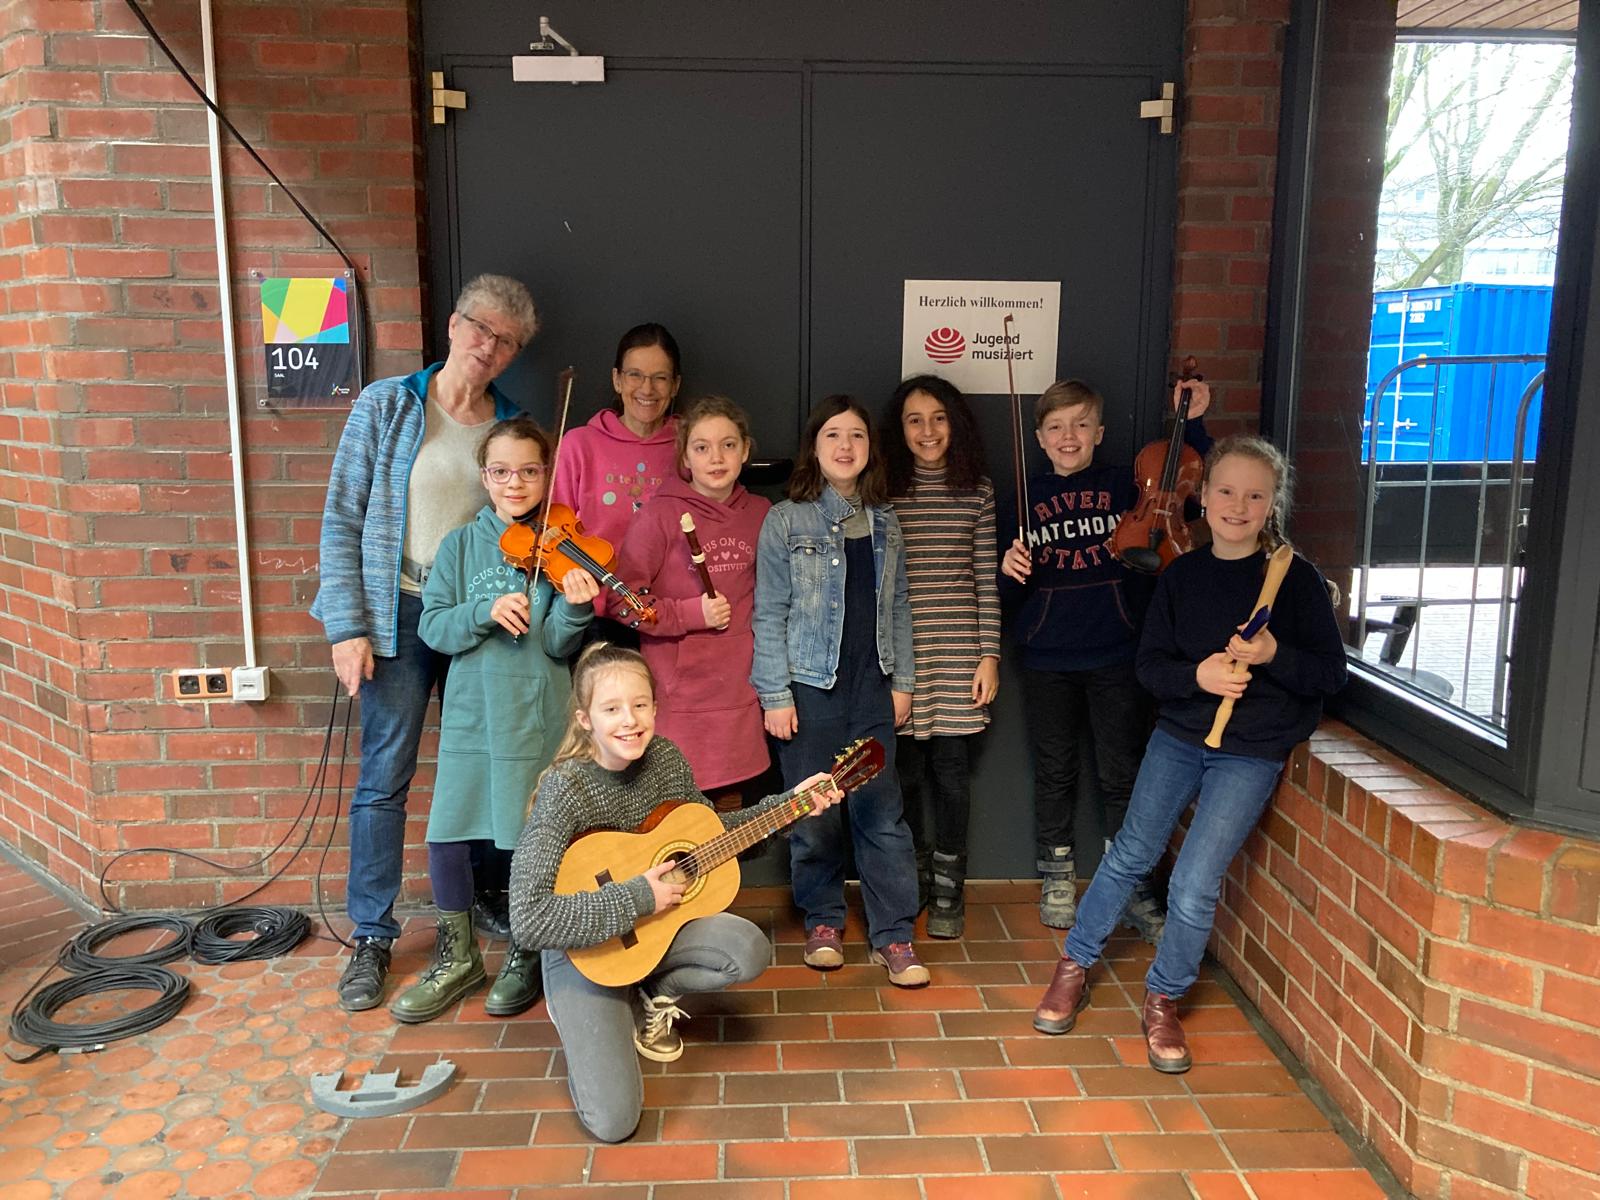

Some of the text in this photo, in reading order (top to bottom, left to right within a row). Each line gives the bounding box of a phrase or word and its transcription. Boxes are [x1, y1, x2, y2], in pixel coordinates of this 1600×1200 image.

[919, 295, 1044, 309] Herzlich willkommen!
[972, 333, 1020, 347] Jugend
[271, 347, 319, 370] 104
[972, 349, 1034, 361] musiziert
[1034, 490, 1112, 522] RIVER
[719, 536, 736, 547] ON
[496, 565, 516, 577] ON
